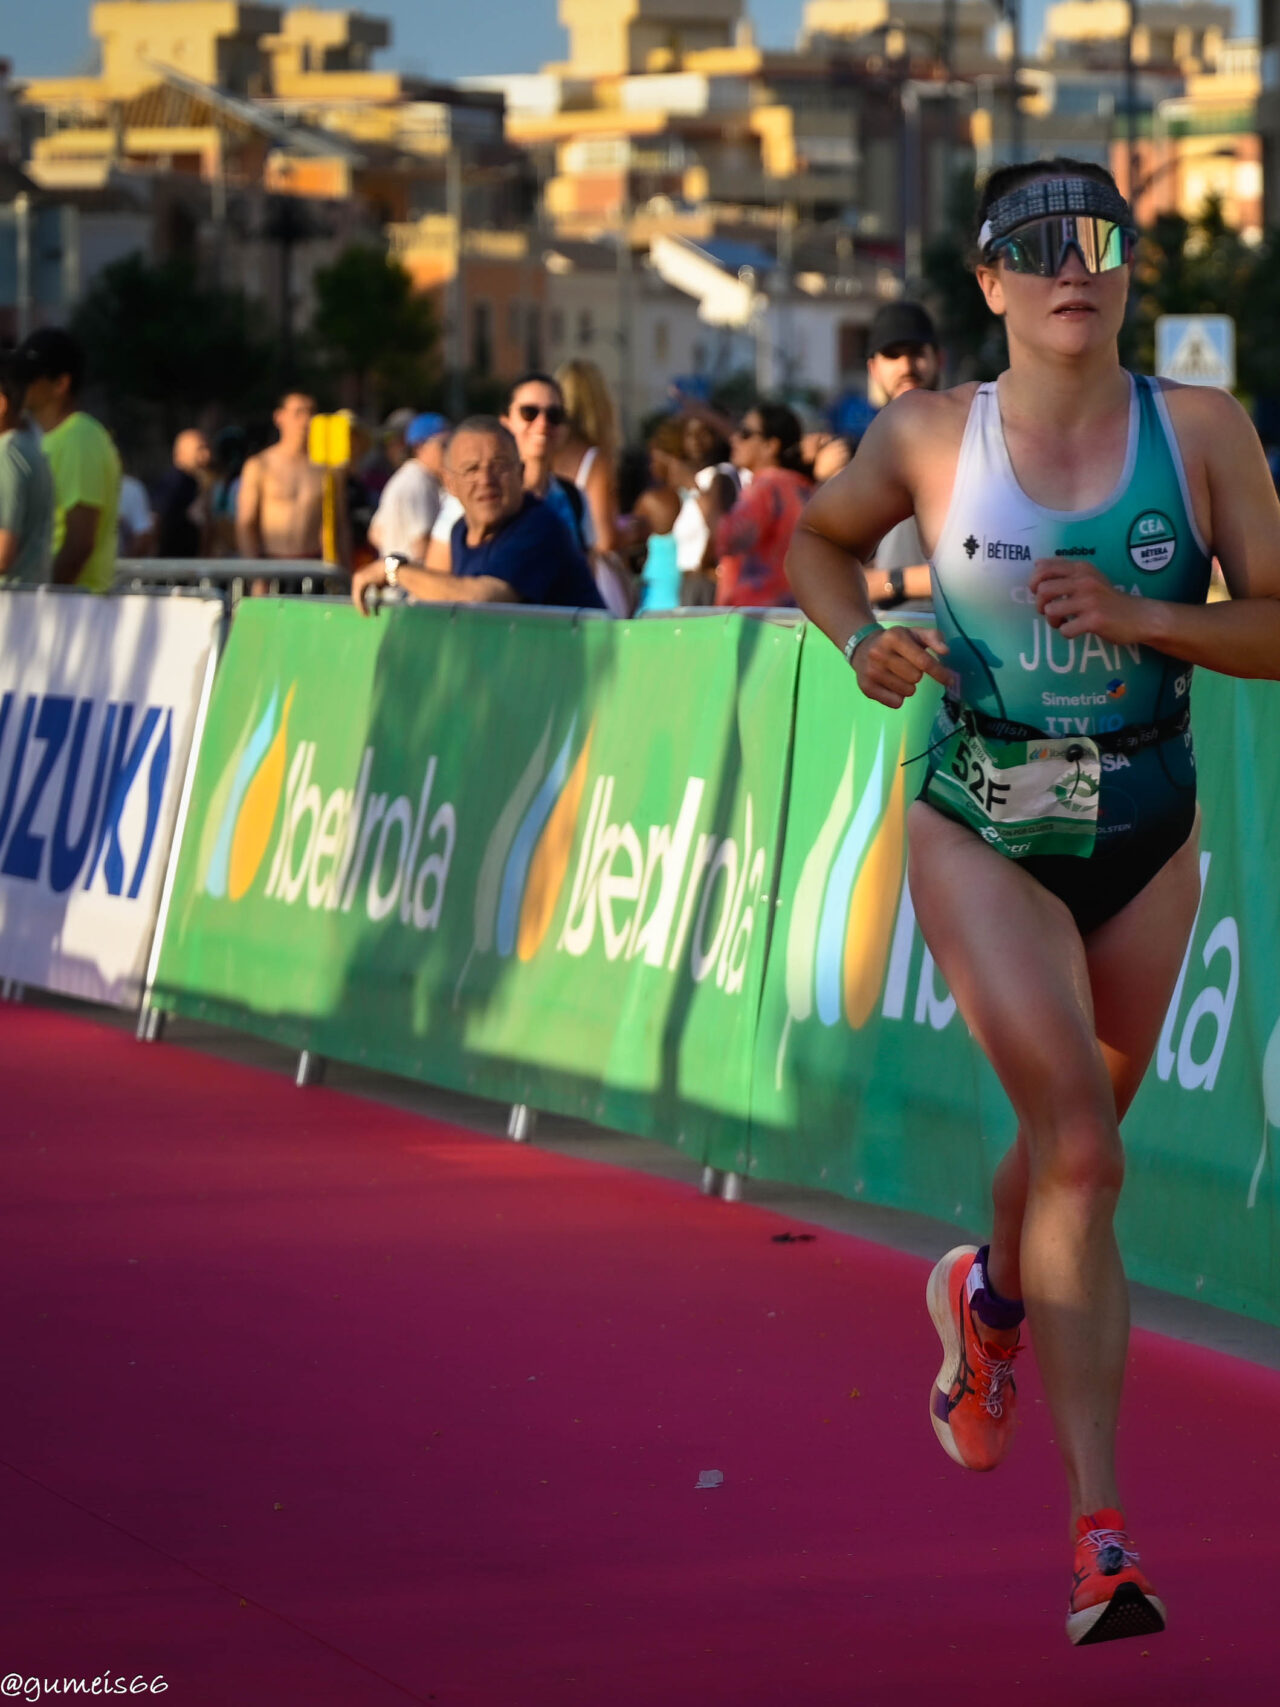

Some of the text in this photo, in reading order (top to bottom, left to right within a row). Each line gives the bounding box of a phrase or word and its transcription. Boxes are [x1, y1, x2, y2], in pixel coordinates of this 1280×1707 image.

[1139, 519, 1165, 534] CEA
[987, 541, 1031, 560] BÉTERA
[1042, 691, 1107, 706] Simetria
[952, 740, 1010, 812] 52F
[264, 740, 456, 931] Iberdrola
